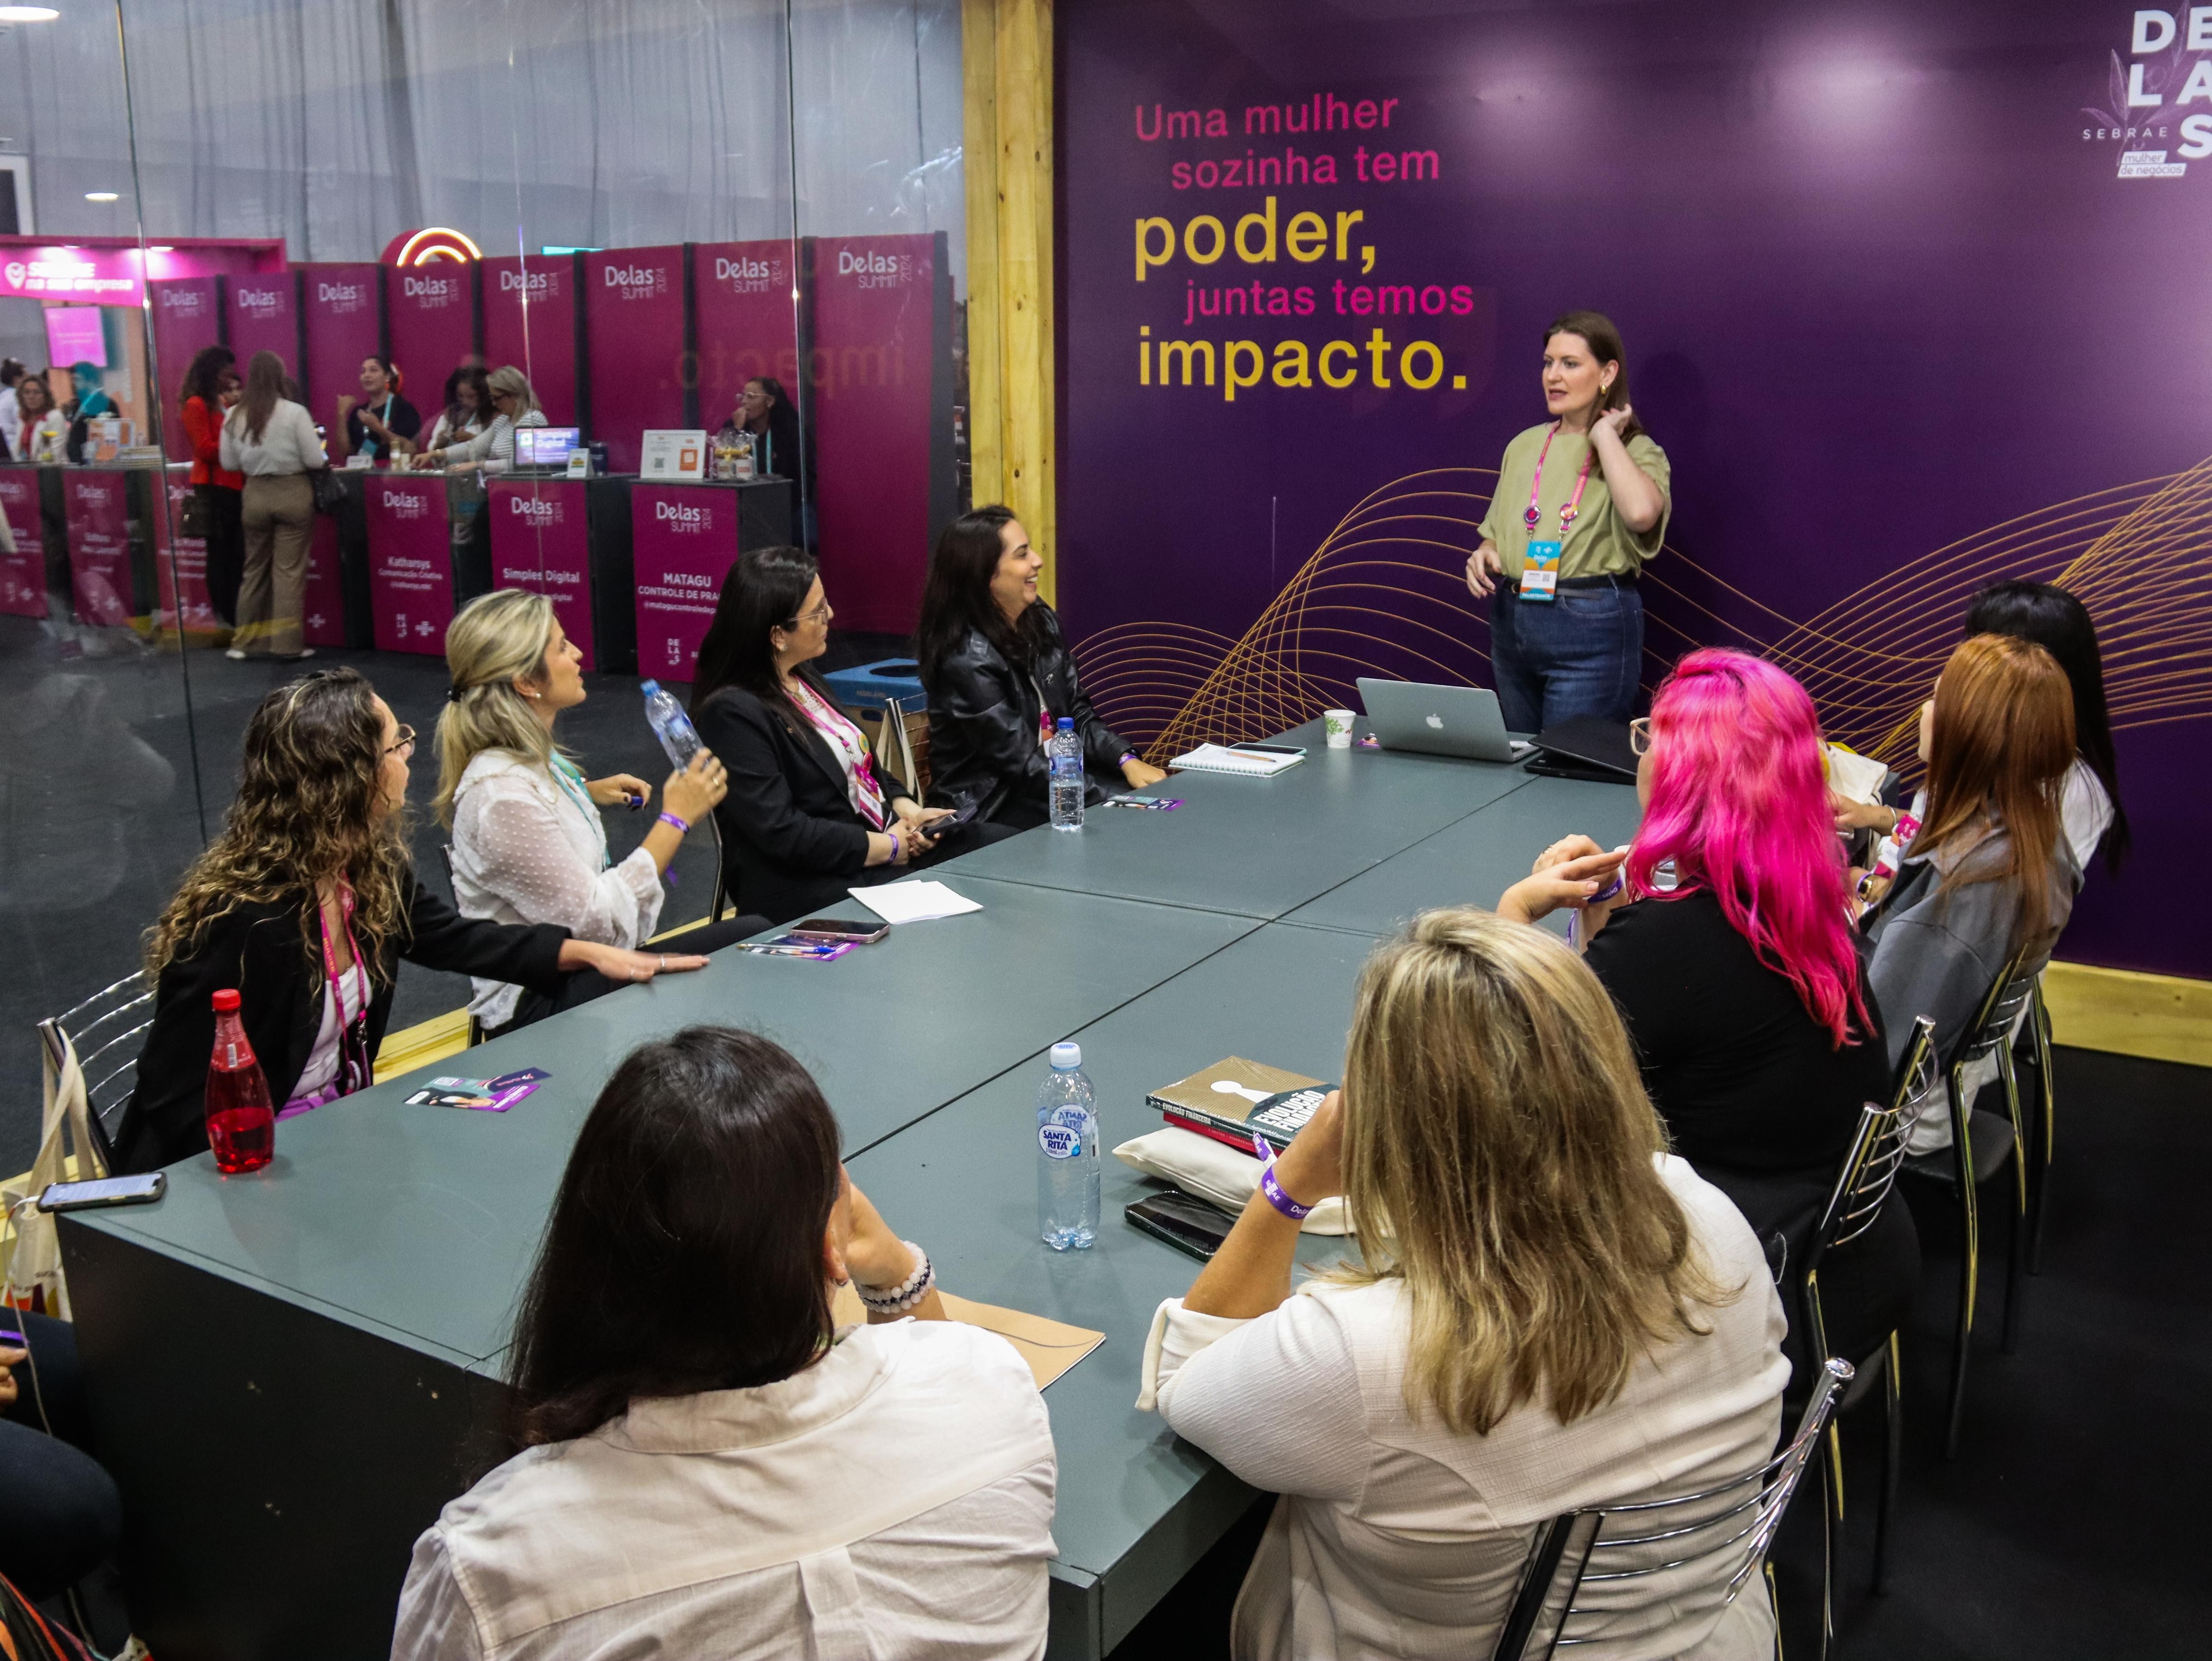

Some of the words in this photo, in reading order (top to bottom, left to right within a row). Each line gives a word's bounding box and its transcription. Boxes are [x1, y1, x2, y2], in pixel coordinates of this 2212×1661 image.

[2132, 6, 2212, 54] DE
[1136, 104, 1228, 141] Uma
[1245, 93, 1398, 135] mulher
[2083, 127, 2167, 139] SEBRAE
[1171, 148, 1337, 189] sozinha
[1354, 146, 1440, 182] tem
[2124, 153, 2163, 162] mulher
[2121, 164, 2133, 174] de
[2136, 164, 2183, 176] negócios
[1136, 196, 1375, 281] poder,
[716, 257, 769, 279] Delas
[839, 251, 897, 274] Delas
[405, 276, 447, 296] Delas
[500, 270, 547, 290] Delas
[605, 265, 654, 287] Delas
[318, 282, 357, 301] Delas
[1184, 279, 1315, 325] juntas
[1332, 279, 1474, 315] temos
[1140, 326, 1466, 401] impacto.
[383, 491, 419, 508] Delas
[511, 496, 553, 515] Delas
[656, 501, 700, 521] Delas
[503, 567, 542, 581] Simples
[546, 570, 580, 583] Digital
[663, 572, 712, 588] MATAGU
[638, 586, 684, 598] CONTROLE
[686, 590, 698, 599] DE
[700, 591, 721, 601] PRA
[1273, 1098, 1326, 1132] FINANC
[1043, 1130, 1071, 1142] SANTA
[1048, 1140, 1068, 1150] RITA
[1290, 1205, 1309, 1214] Dela
